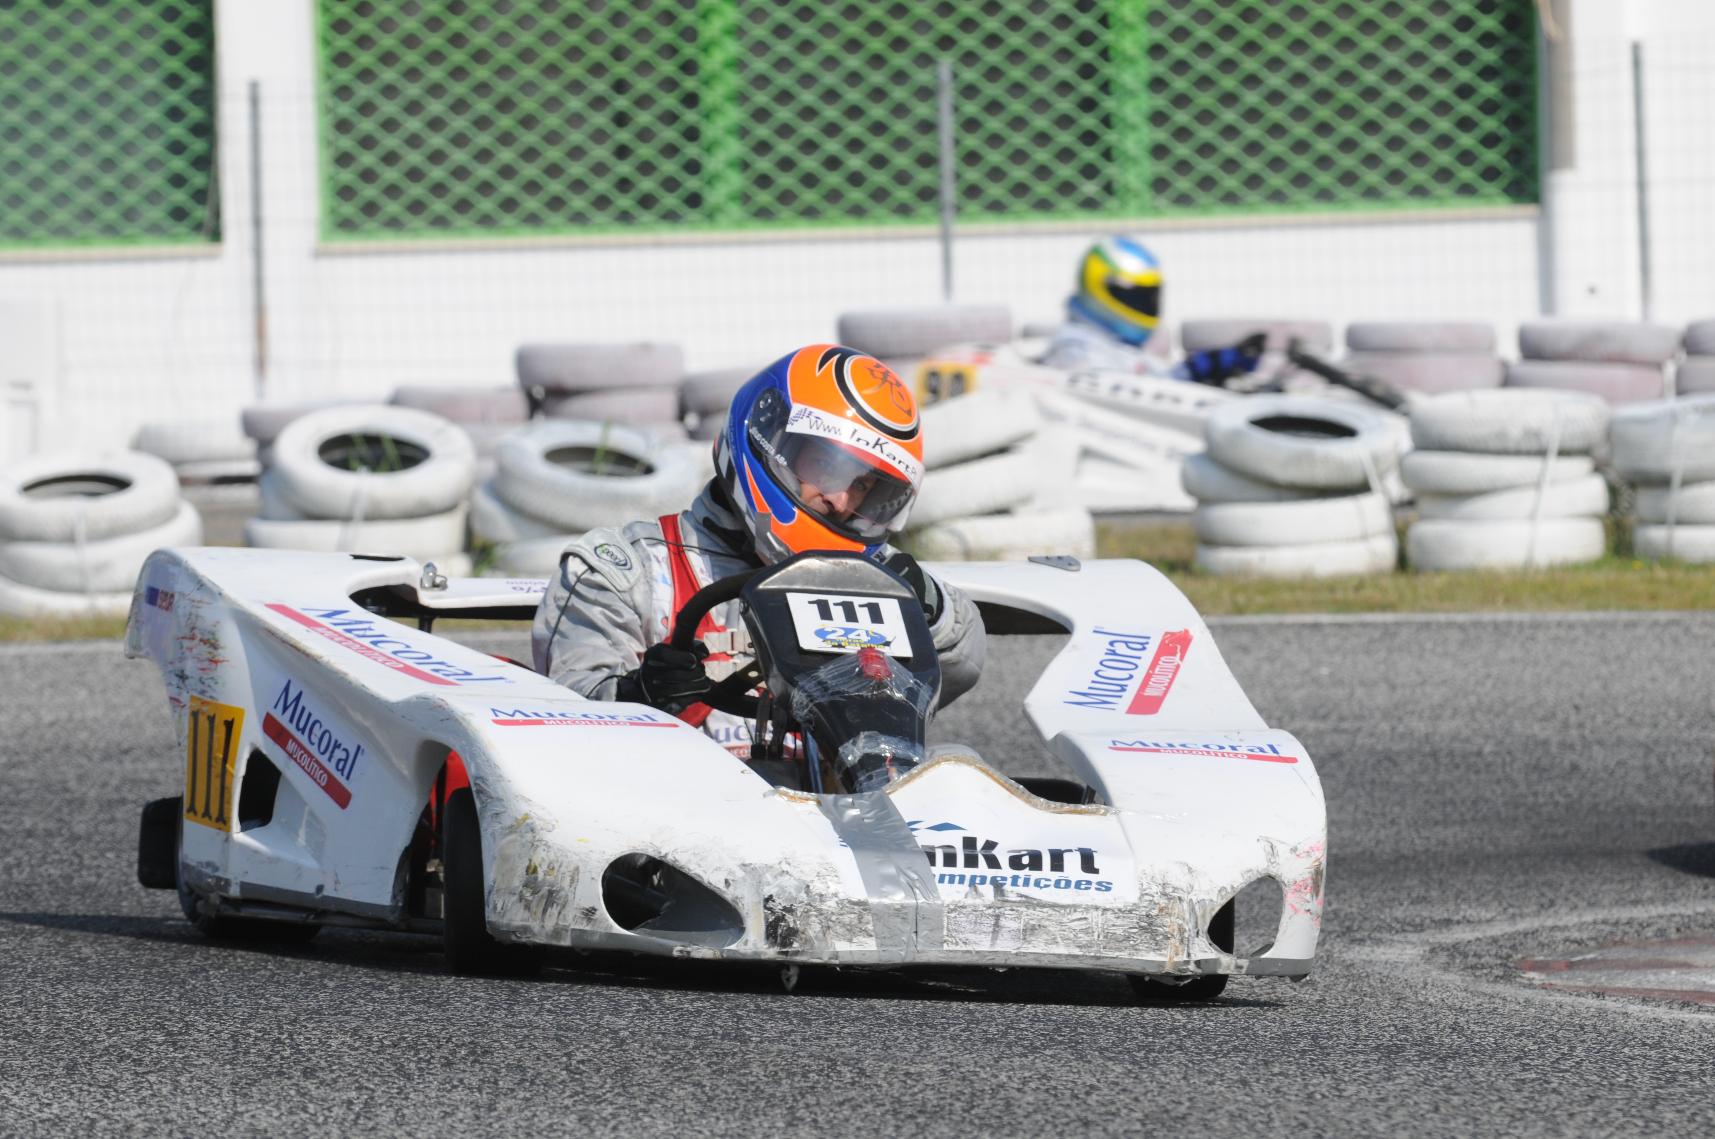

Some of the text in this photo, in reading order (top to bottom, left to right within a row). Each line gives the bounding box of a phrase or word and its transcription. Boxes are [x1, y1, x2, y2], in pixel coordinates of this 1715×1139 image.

[808, 599, 884, 625] 111
[300, 607, 506, 682] Mucoral
[823, 626, 871, 642] 24
[1063, 629, 1151, 711] Mucoral
[490, 707, 659, 722] Mucoral
[273, 679, 361, 781] Mucoral
[1111, 740, 1281, 756] Mucoral
[186, 708, 235, 826] 111
[933, 873, 1114, 892] mpetições
